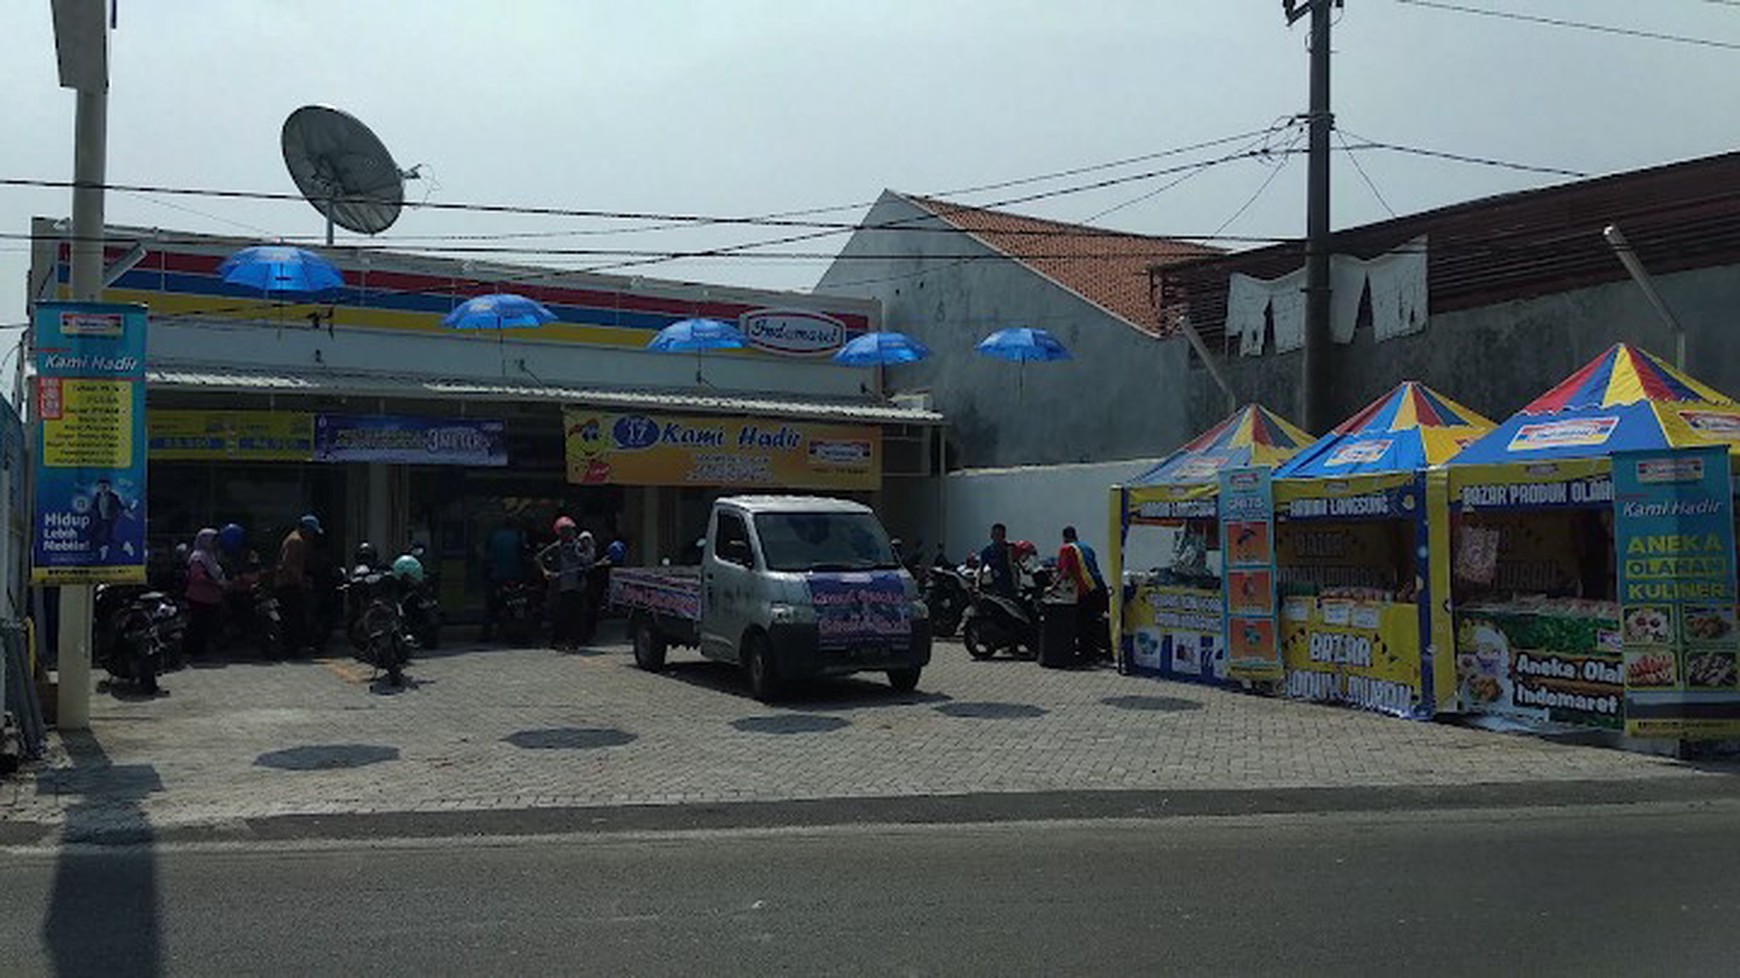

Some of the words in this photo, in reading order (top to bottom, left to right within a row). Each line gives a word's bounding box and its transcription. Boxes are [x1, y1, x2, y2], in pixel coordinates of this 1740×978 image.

[45, 354, 88, 370] Kami
[91, 356, 137, 371] Hadir
[662, 422, 724, 446] Kami
[738, 426, 801, 447] Hadir
[1463, 485, 1507, 505] BAZAR
[1509, 481, 1567, 505] PRODUK
[1623, 500, 1669, 518] Kami
[44, 512, 91, 529] Hidup
[43, 528, 79, 540] Lebih
[1627, 533, 1722, 554] ANEKA
[1628, 560, 1724, 576] OLAHAN
[1628, 581, 1725, 600] KULINER
[1517, 654, 1576, 679] Aneka
[1516, 682, 1619, 715] Indomaret
